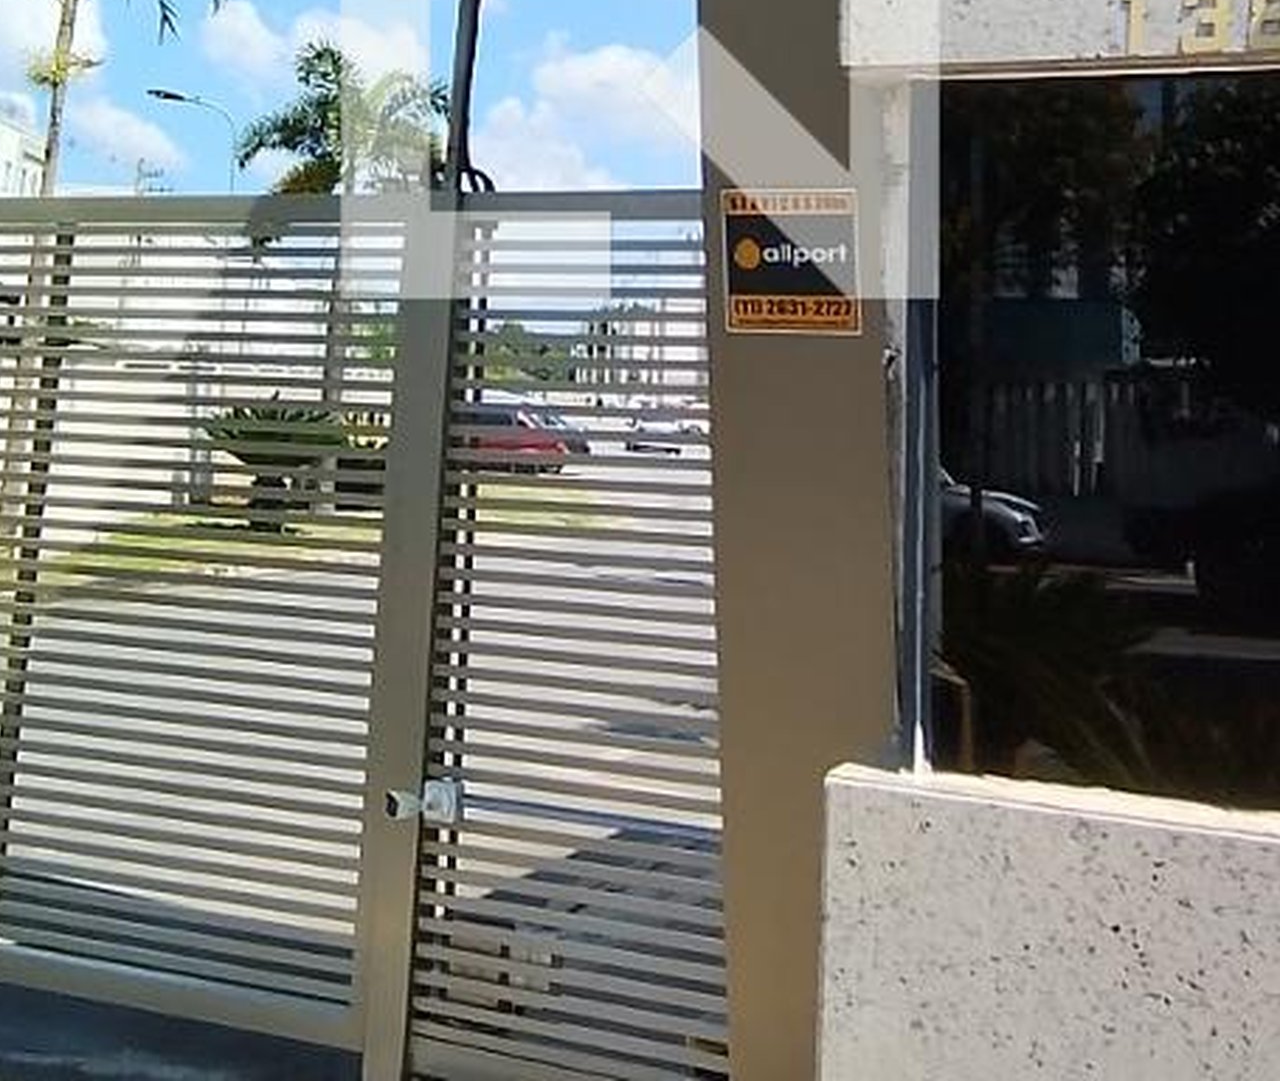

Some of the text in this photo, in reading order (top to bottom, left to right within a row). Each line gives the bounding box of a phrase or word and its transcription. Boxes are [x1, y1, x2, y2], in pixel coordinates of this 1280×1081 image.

[762, 243, 847, 267] allport
[734, 299, 852, 317] (11) 2631-2727
